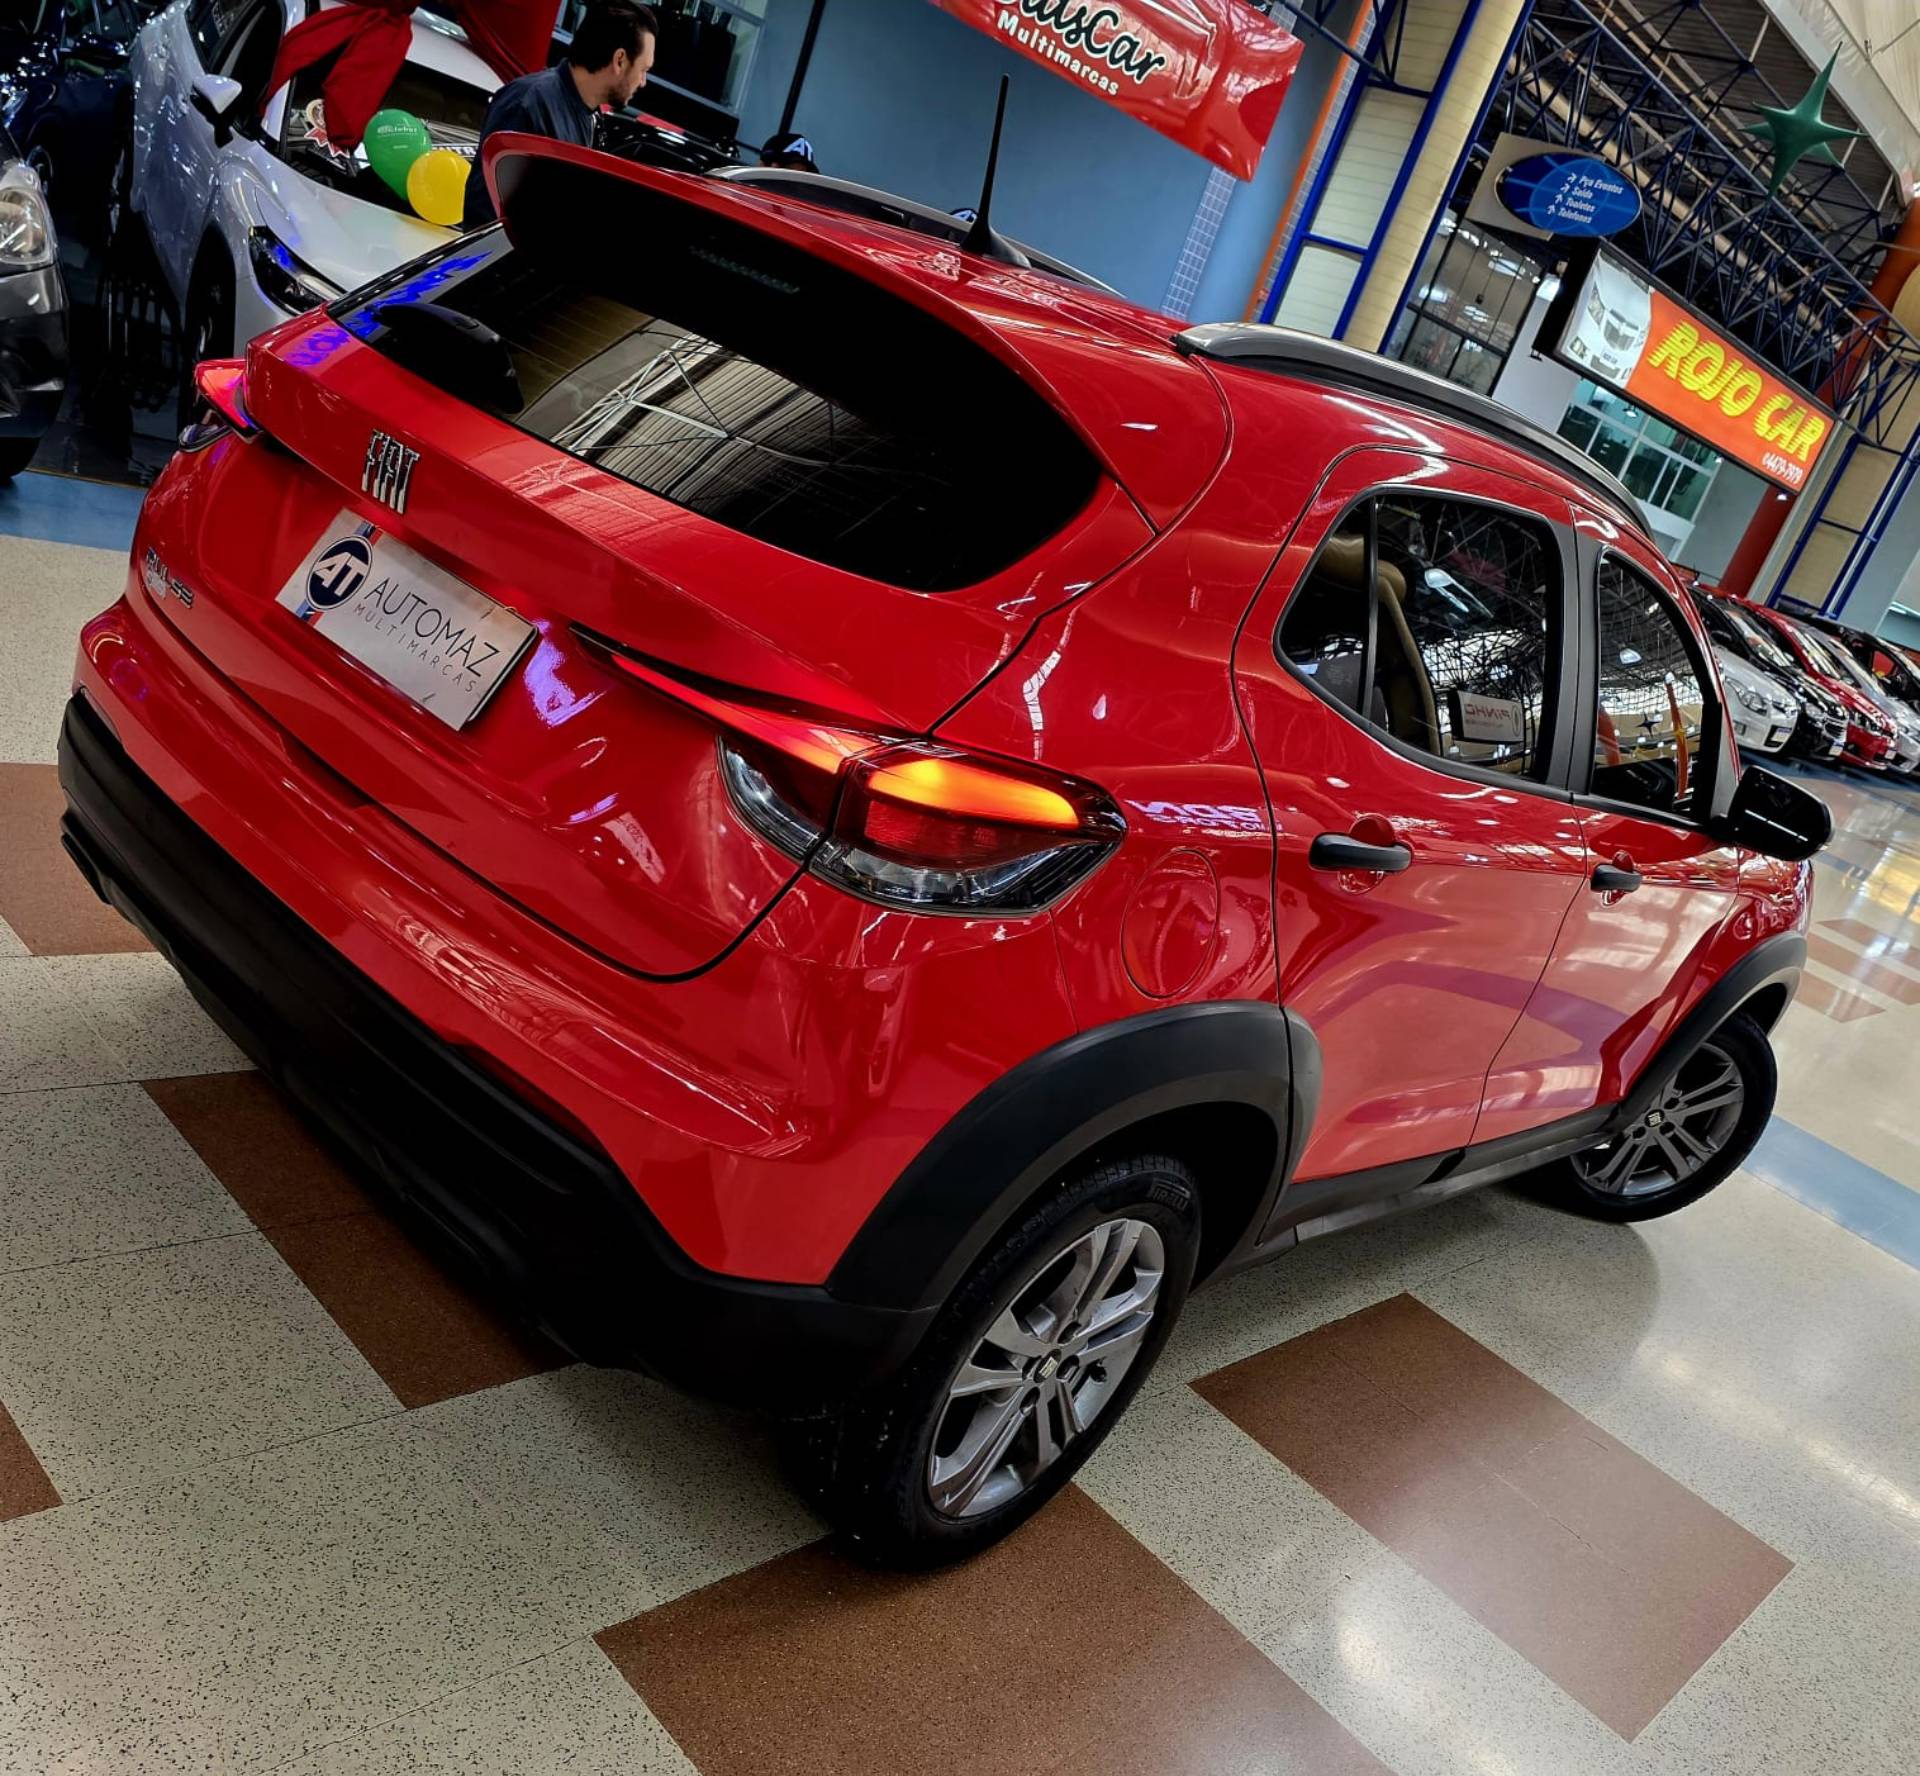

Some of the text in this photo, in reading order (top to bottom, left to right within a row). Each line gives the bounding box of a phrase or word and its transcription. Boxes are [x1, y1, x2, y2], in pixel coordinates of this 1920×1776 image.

[997, 10, 1119, 95] Multimarcas
[1558, 207, 1593, 224] Telefones
[1565, 197, 1596, 213] Toaletes
[1648, 320, 1825, 462] ROJO CAR
[354, 603, 478, 692] MULTIMARCAS
[364, 577, 500, 678] AUTOMAZ
